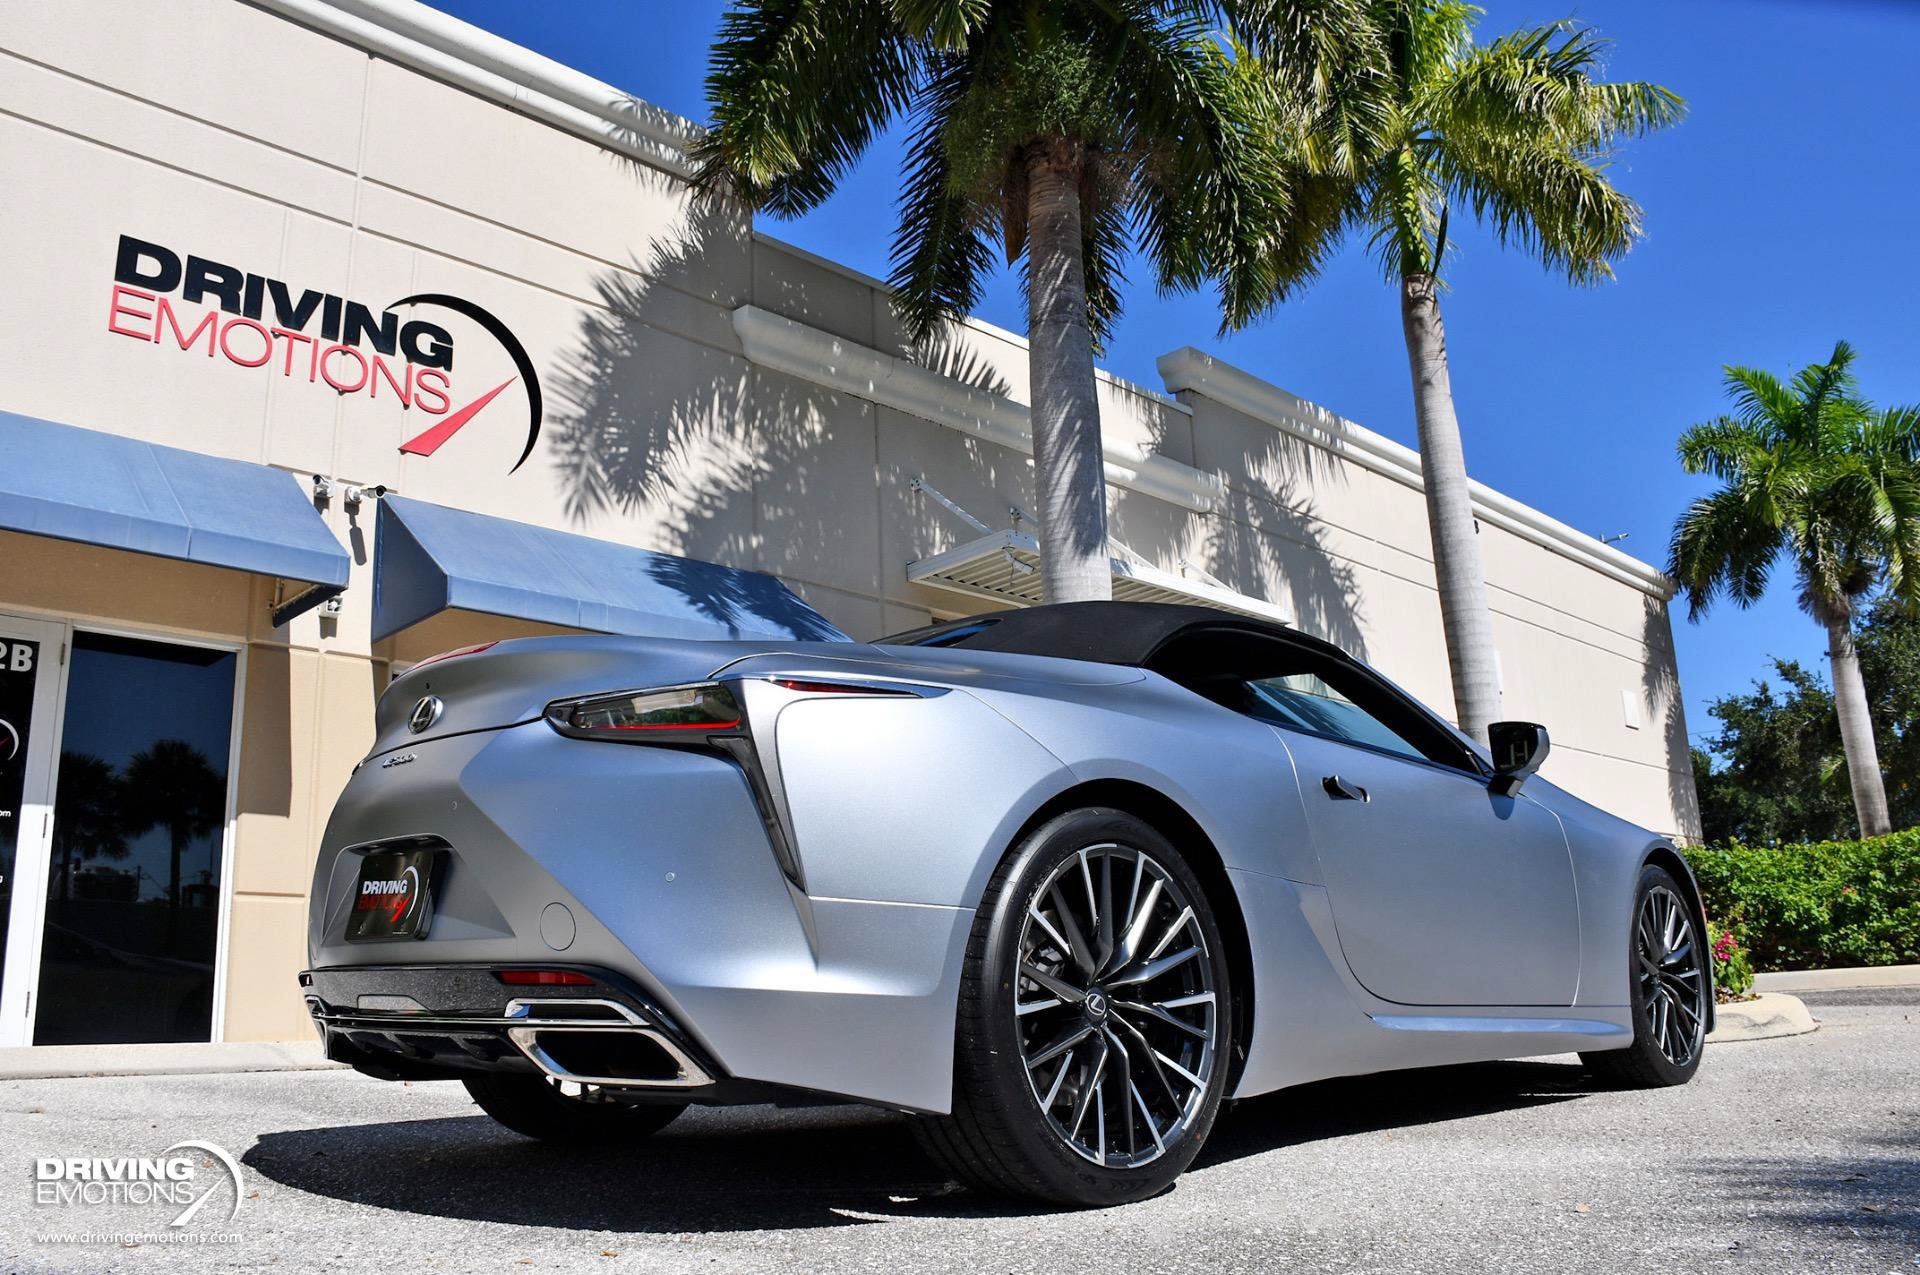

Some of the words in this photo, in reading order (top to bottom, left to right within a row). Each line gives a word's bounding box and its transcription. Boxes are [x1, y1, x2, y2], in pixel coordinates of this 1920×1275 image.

[109, 285, 450, 414] EMOTIONS
[114, 234, 453, 371] DRIVING
[362, 880, 408, 895] DRIVING
